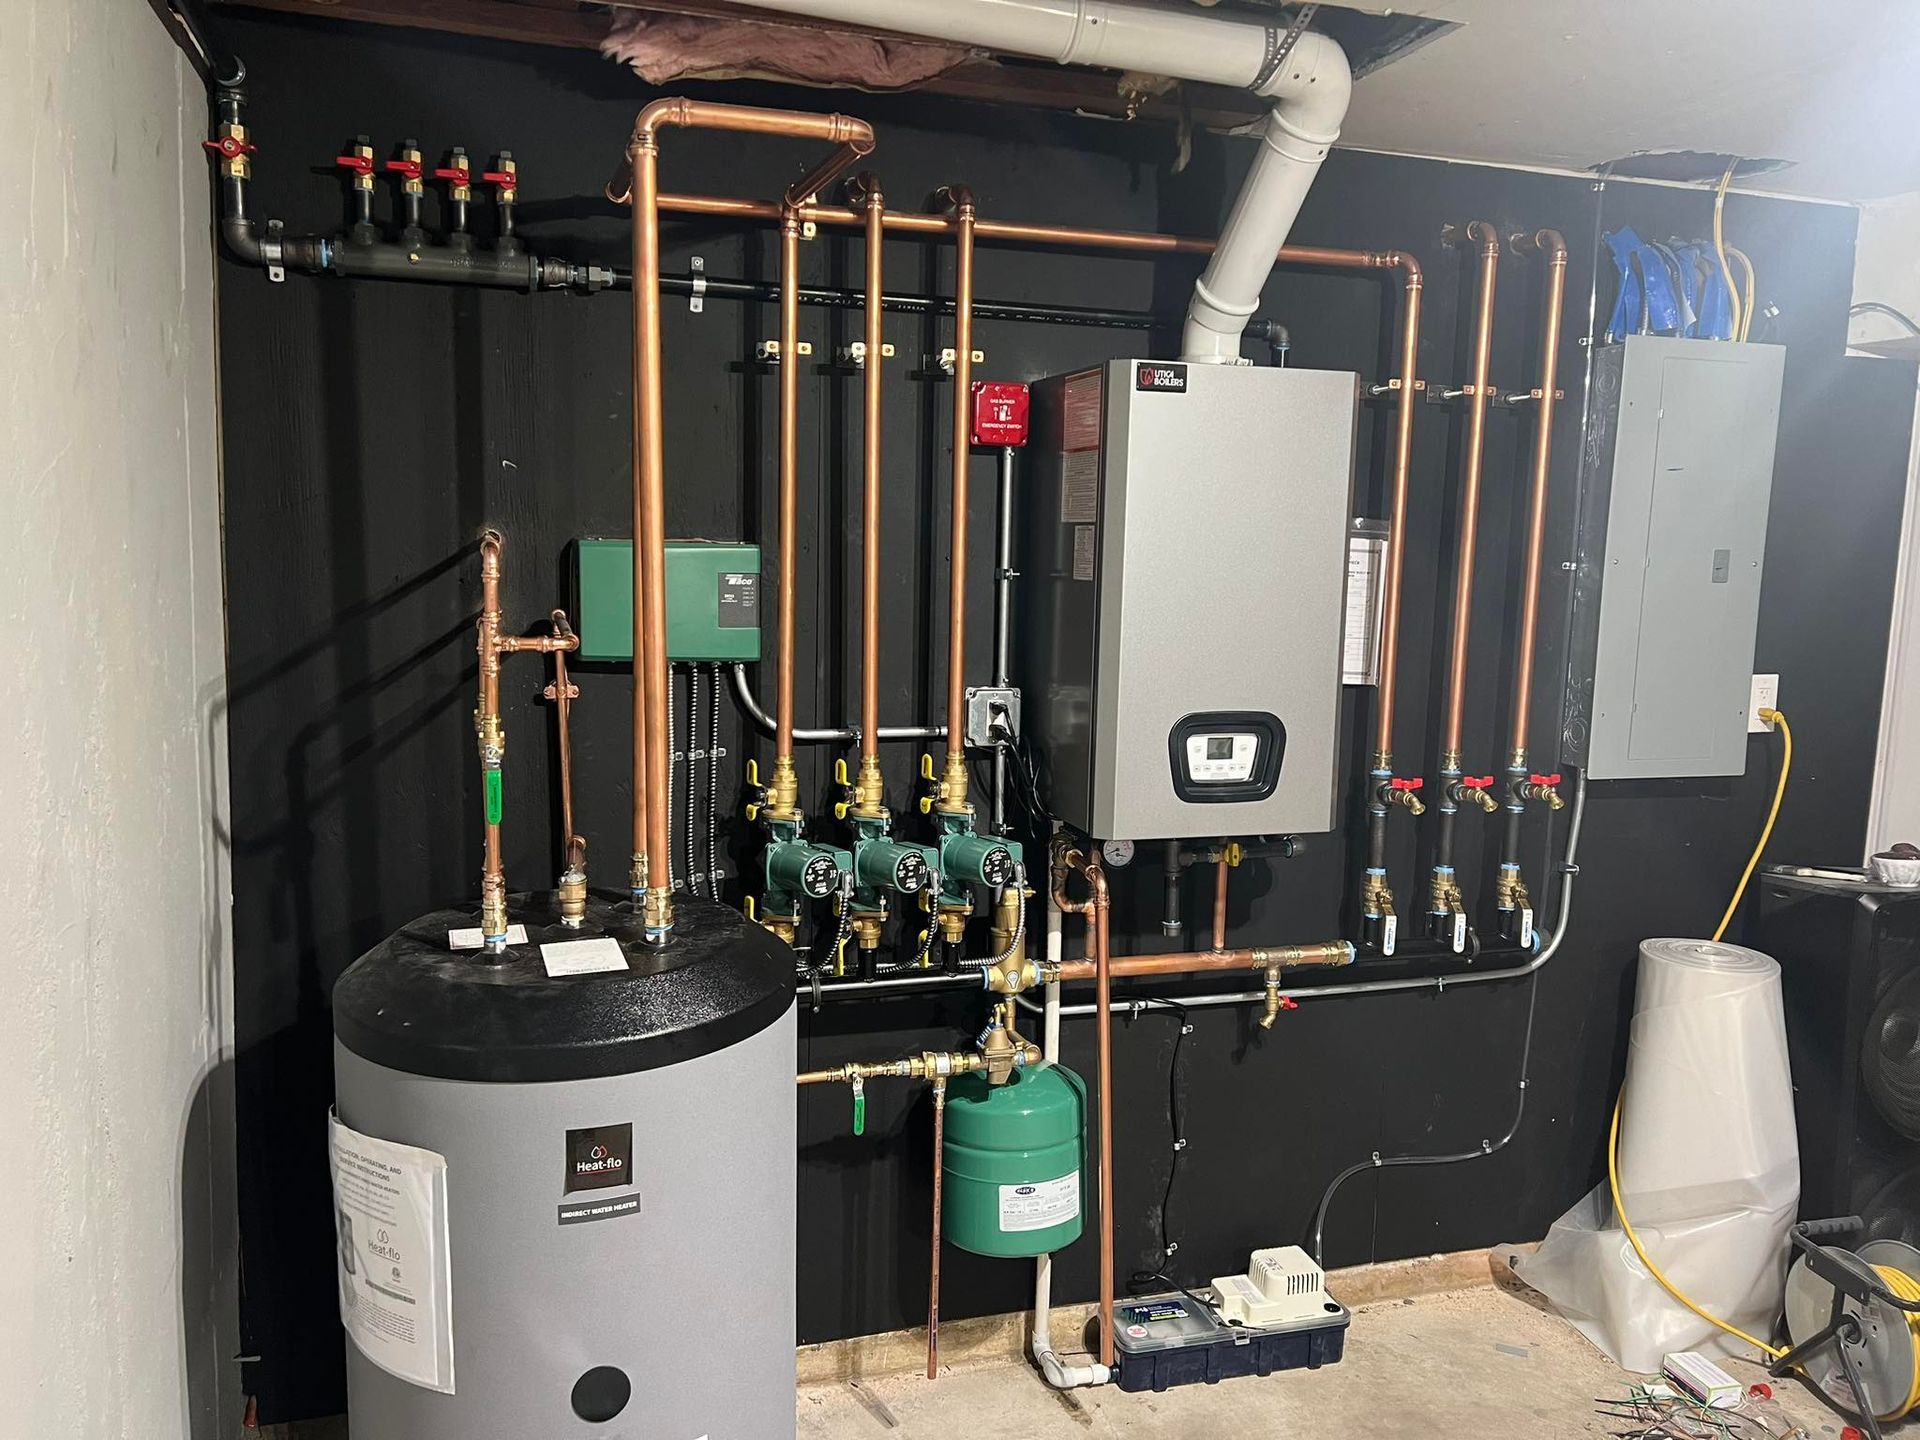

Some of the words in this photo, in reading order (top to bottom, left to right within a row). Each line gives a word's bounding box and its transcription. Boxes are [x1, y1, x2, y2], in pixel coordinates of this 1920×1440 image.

[1154, 369, 1175, 379] UTICA
[1153, 377, 1184, 387] BOILERS
[577, 1157, 622, 1172] Heat-flo
[561, 1209, 591, 1219] INDIRECT
[591, 1205, 613, 1215] WATER
[613, 1201, 637, 1211] HEATER
[368, 1240, 400, 1261] Heat-flo
